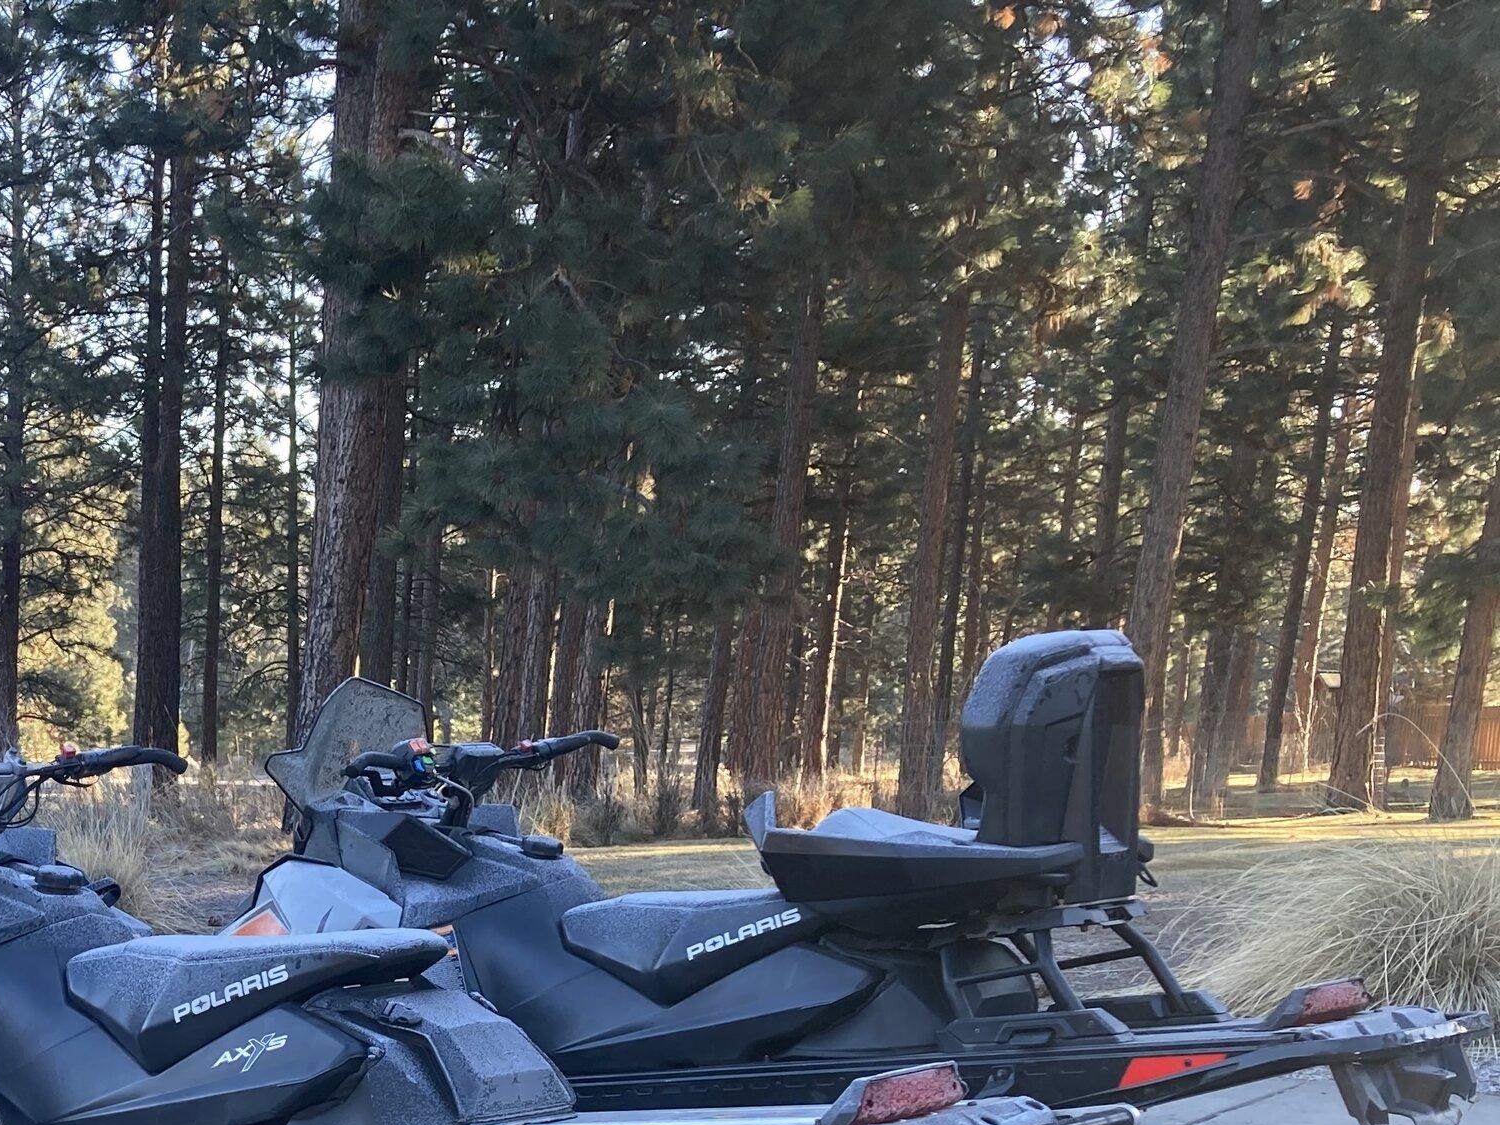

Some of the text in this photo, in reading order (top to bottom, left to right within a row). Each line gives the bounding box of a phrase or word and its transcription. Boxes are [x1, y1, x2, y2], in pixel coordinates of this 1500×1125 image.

[686, 907, 801, 961] POLARIS
[172, 964, 289, 1024] POLARIS
[211, 1032, 288, 1073] AXYS
